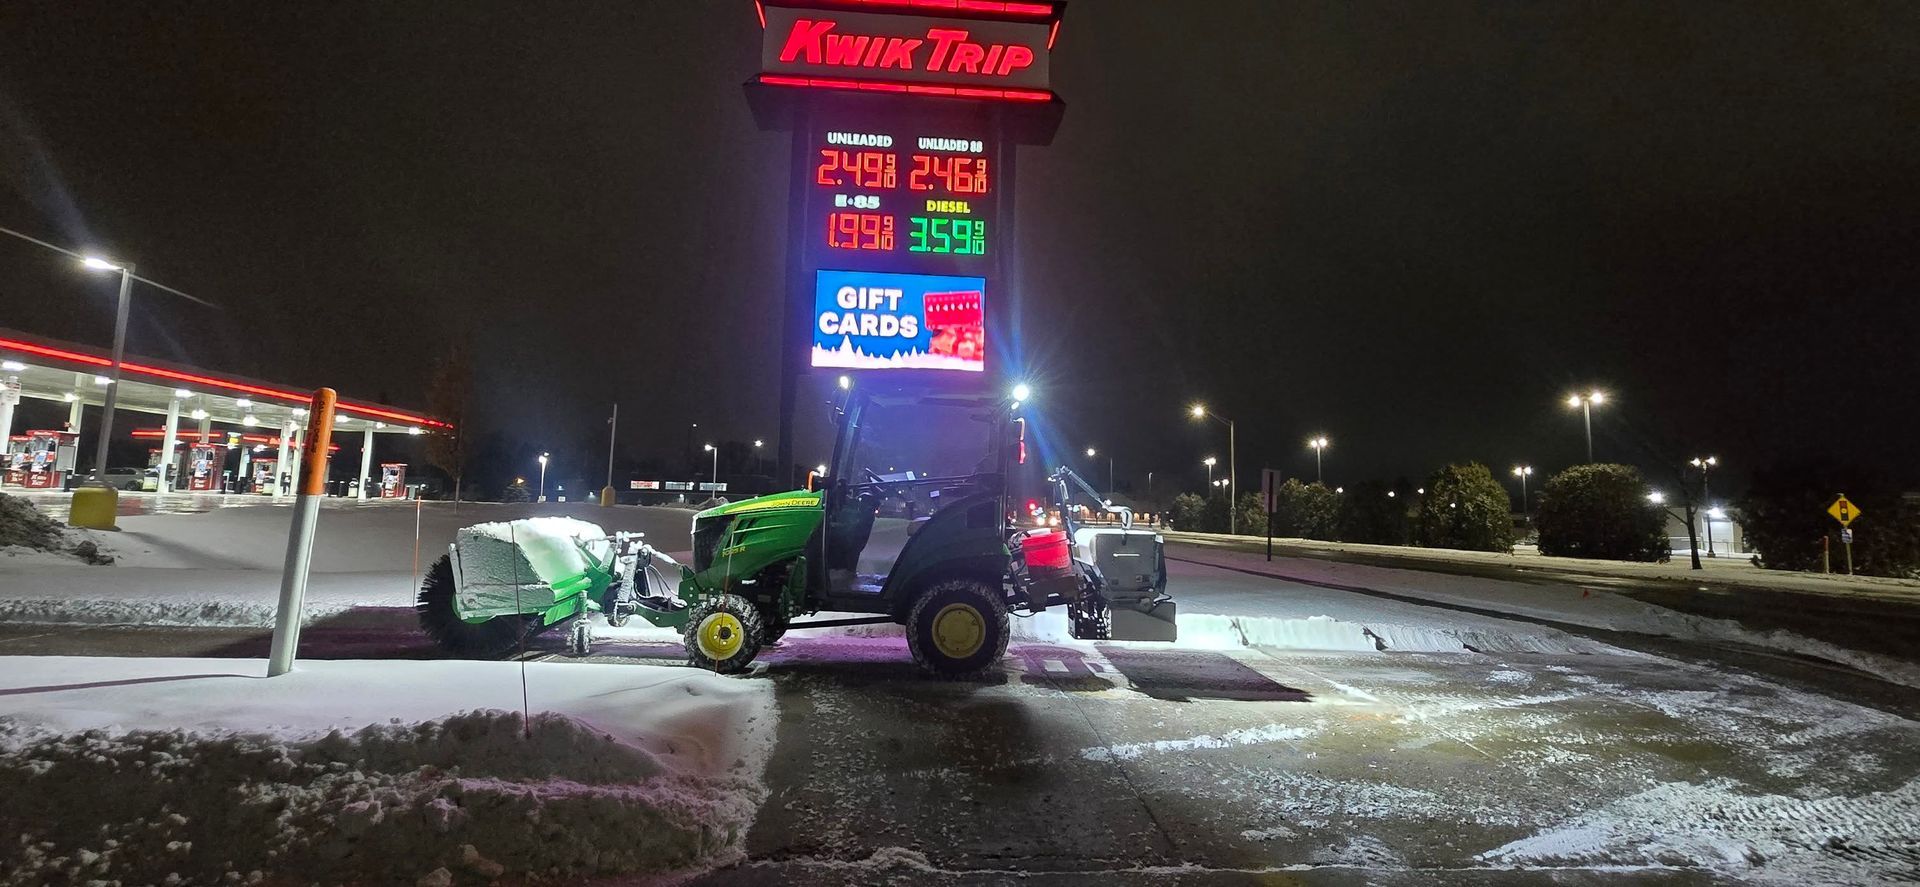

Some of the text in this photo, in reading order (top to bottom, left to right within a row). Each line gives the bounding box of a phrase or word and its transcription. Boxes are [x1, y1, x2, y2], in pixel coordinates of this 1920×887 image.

[779, 19, 1034, 76] KWIK TRIP
[827, 132, 893, 147] UNLEADED
[918, 137, 984, 153] UNLEADED 88
[926, 200, 970, 214] DIESEL
[837, 286, 903, 311] GIFT
[818, 311, 918, 338] CARDS
